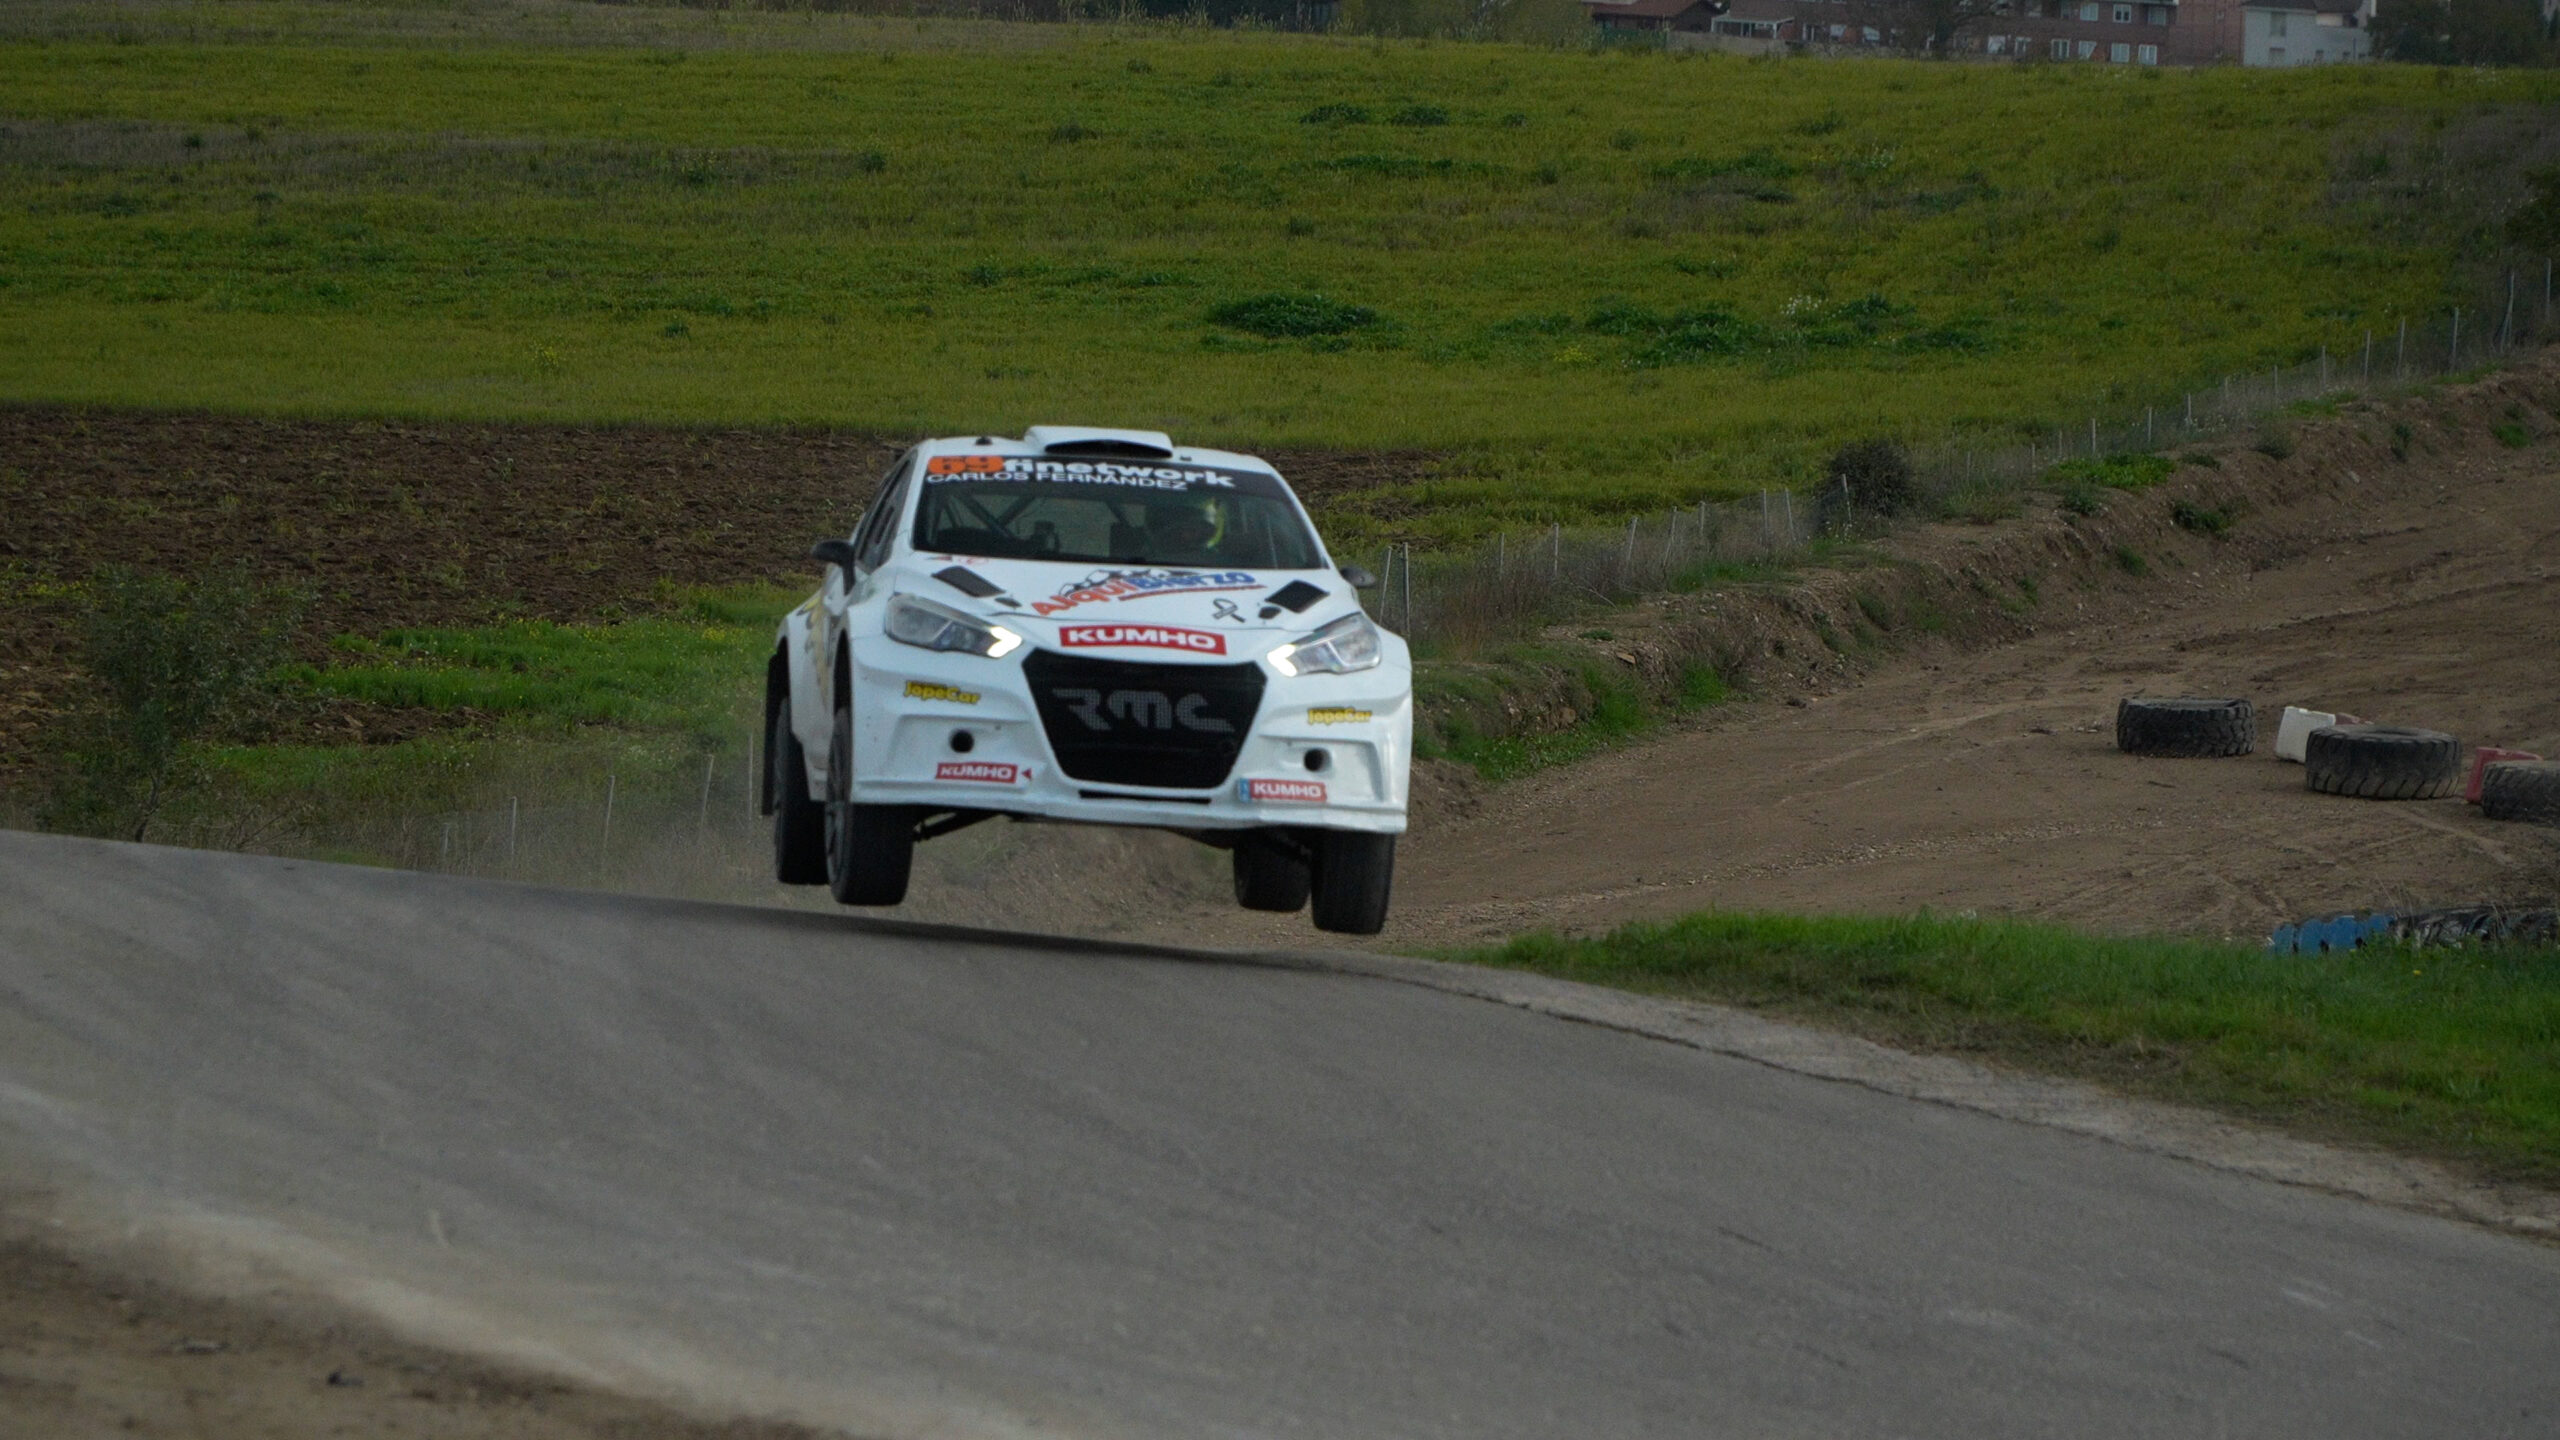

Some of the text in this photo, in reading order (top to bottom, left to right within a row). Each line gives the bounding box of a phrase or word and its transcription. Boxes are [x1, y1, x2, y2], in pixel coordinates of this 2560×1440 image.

[926, 472, 1039, 484] CARLOS
[1003, 457, 1236, 488] finetwork
[1068, 628, 1217, 648] KUMHO
[940, 765, 1013, 779] KUMHO
[1254, 782, 1322, 798] KUMHO
